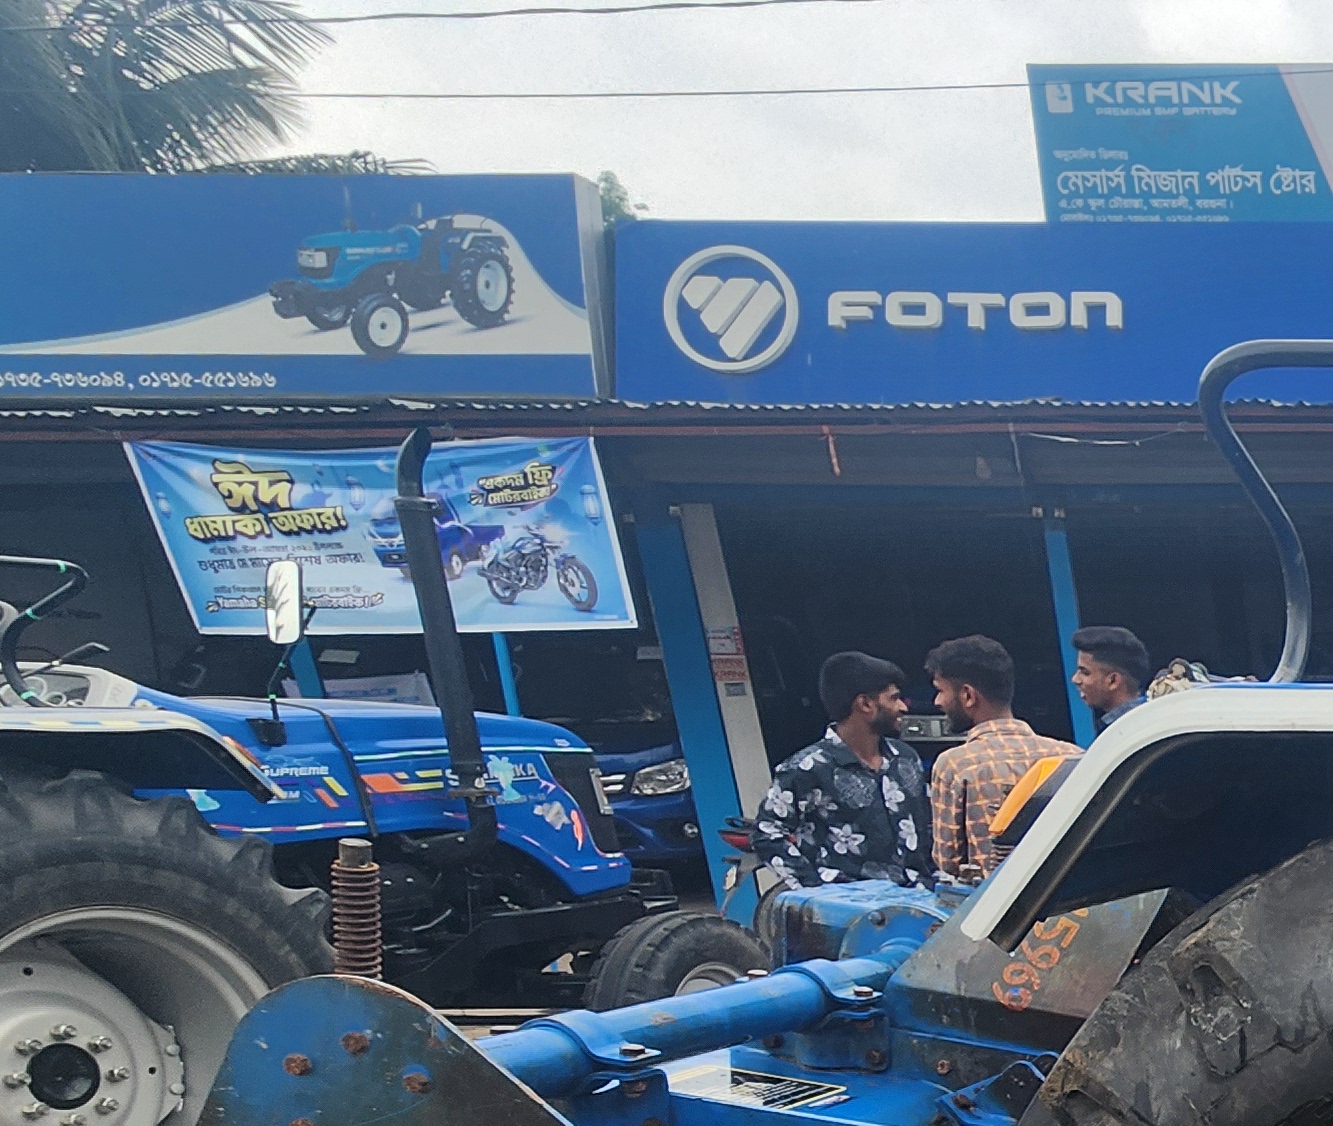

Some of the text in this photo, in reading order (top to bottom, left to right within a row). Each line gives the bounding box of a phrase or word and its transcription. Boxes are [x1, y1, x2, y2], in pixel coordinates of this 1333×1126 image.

[1084, 81, 1243, 104] KRANK
[1057, 163, 1126, 194] মেসার্স
[1131, 164, 1199, 194] মিজান
[1206, 164, 1262, 194] পার্টস
[828, 290, 1123, 331] FOTON
[210, 458, 294, 512] ঈদ
[185, 505, 348, 540] ধামাকা অফার!
[992, 908, 1089, 1012] 5969
